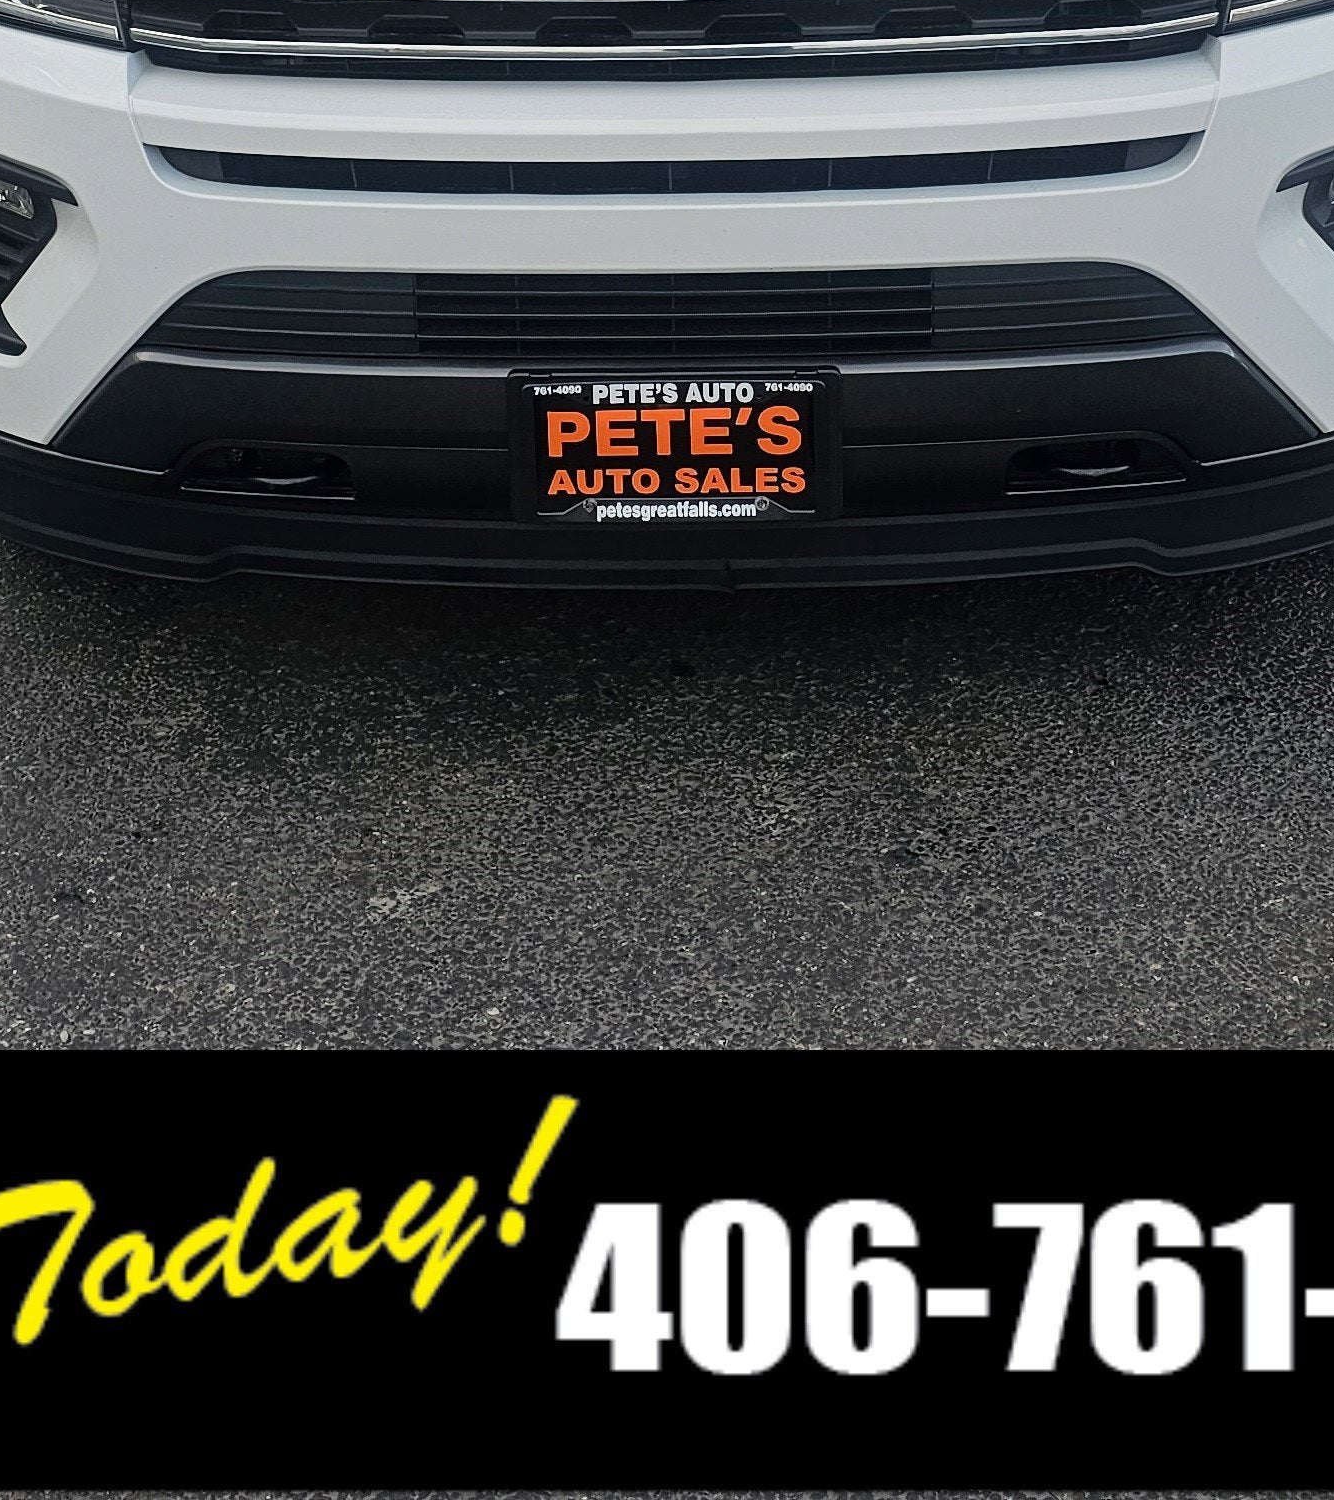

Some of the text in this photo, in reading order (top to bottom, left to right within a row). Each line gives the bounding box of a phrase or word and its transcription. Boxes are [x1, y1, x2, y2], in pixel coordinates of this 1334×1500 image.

[592, 382, 755, 404] PETE'S AUTO
[547, 405, 803, 457] PETE'S
[548, 467, 806, 495] AUTO SALES
[596, 500, 758, 522] petesgreatfalls.com
